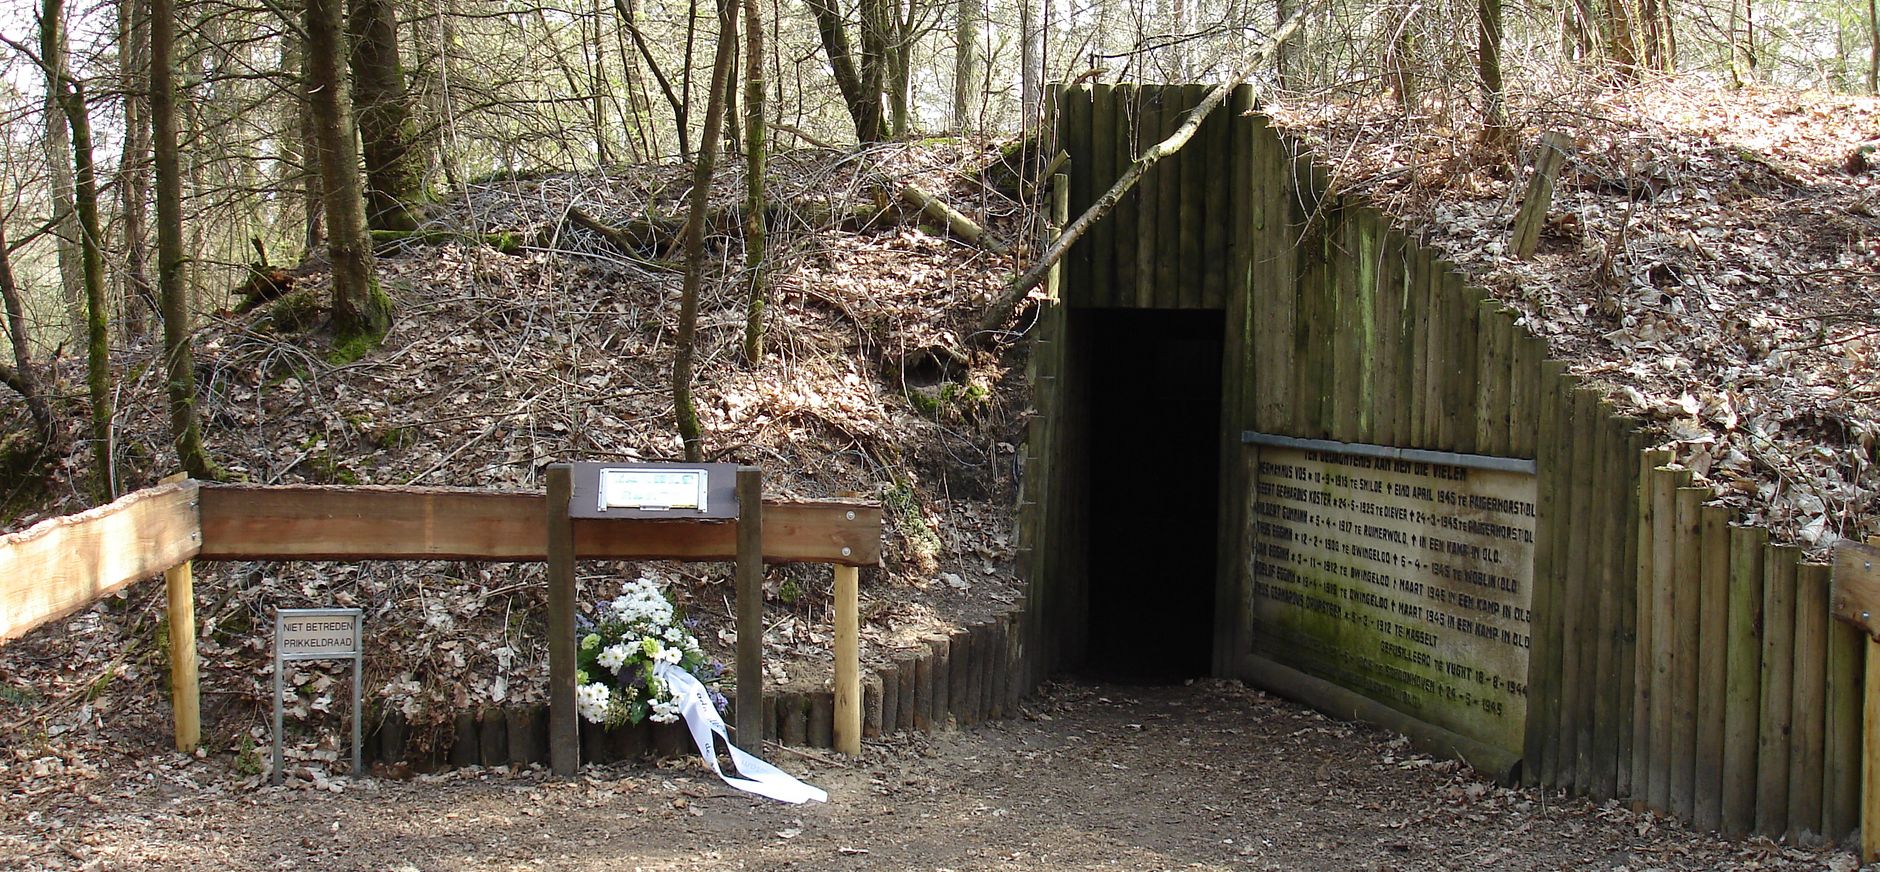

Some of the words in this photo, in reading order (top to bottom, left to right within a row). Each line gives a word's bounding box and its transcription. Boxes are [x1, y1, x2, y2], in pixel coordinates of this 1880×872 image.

[1415, 462, 1429, 476] DIE
[1295, 466, 1306, 480] VOS
[1412, 486, 1433, 501] APRIL
[1437, 489, 1455, 505] 1945
[1458, 494, 1467, 507] TE
[1308, 489, 1331, 506] KOSTER
[1384, 505, 1407, 520] DIEVER
[1429, 537, 1444, 552] EEN
[1399, 578, 1423, 596] MAART
[1427, 585, 1445, 602] 1945
[1502, 603, 1511, 619] IN
[283, 623, 303, 632] NIET
[306, 622, 353, 632] BETREDEN
[1398, 601, 1422, 620] MAART
[1425, 608, 1444, 626] 1945
[1500, 629, 1510, 645] IN
[284, 638, 352, 648] PRIKKELDRAAD
[1445, 660, 1471, 681] VUGHT
